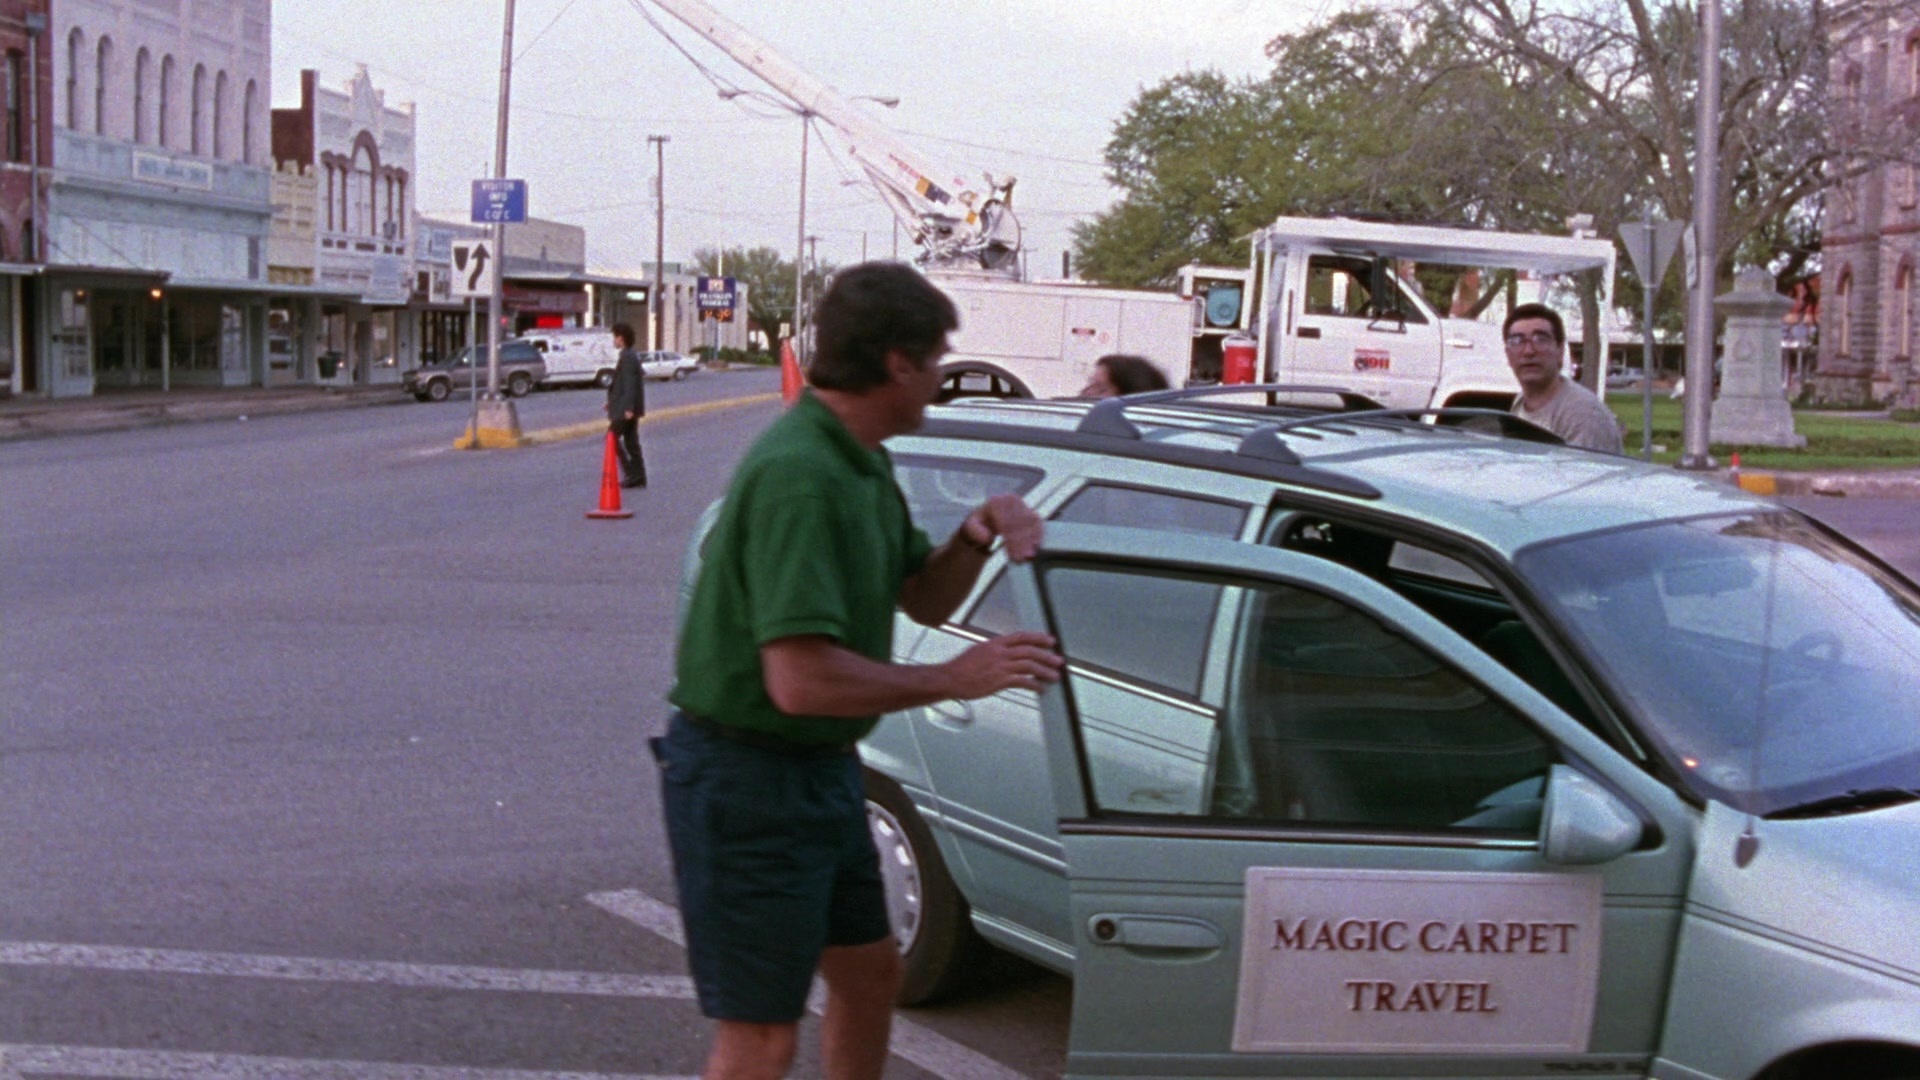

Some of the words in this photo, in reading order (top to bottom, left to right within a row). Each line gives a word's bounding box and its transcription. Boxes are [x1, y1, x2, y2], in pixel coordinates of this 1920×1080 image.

[481, 182, 515, 191] VISITOR
[488, 192, 508, 201] INFO
[1273, 919, 1407, 952] MAGIC
[1419, 922, 1576, 953] CARPET
[1346, 982, 1497, 1012] TRAVEL
